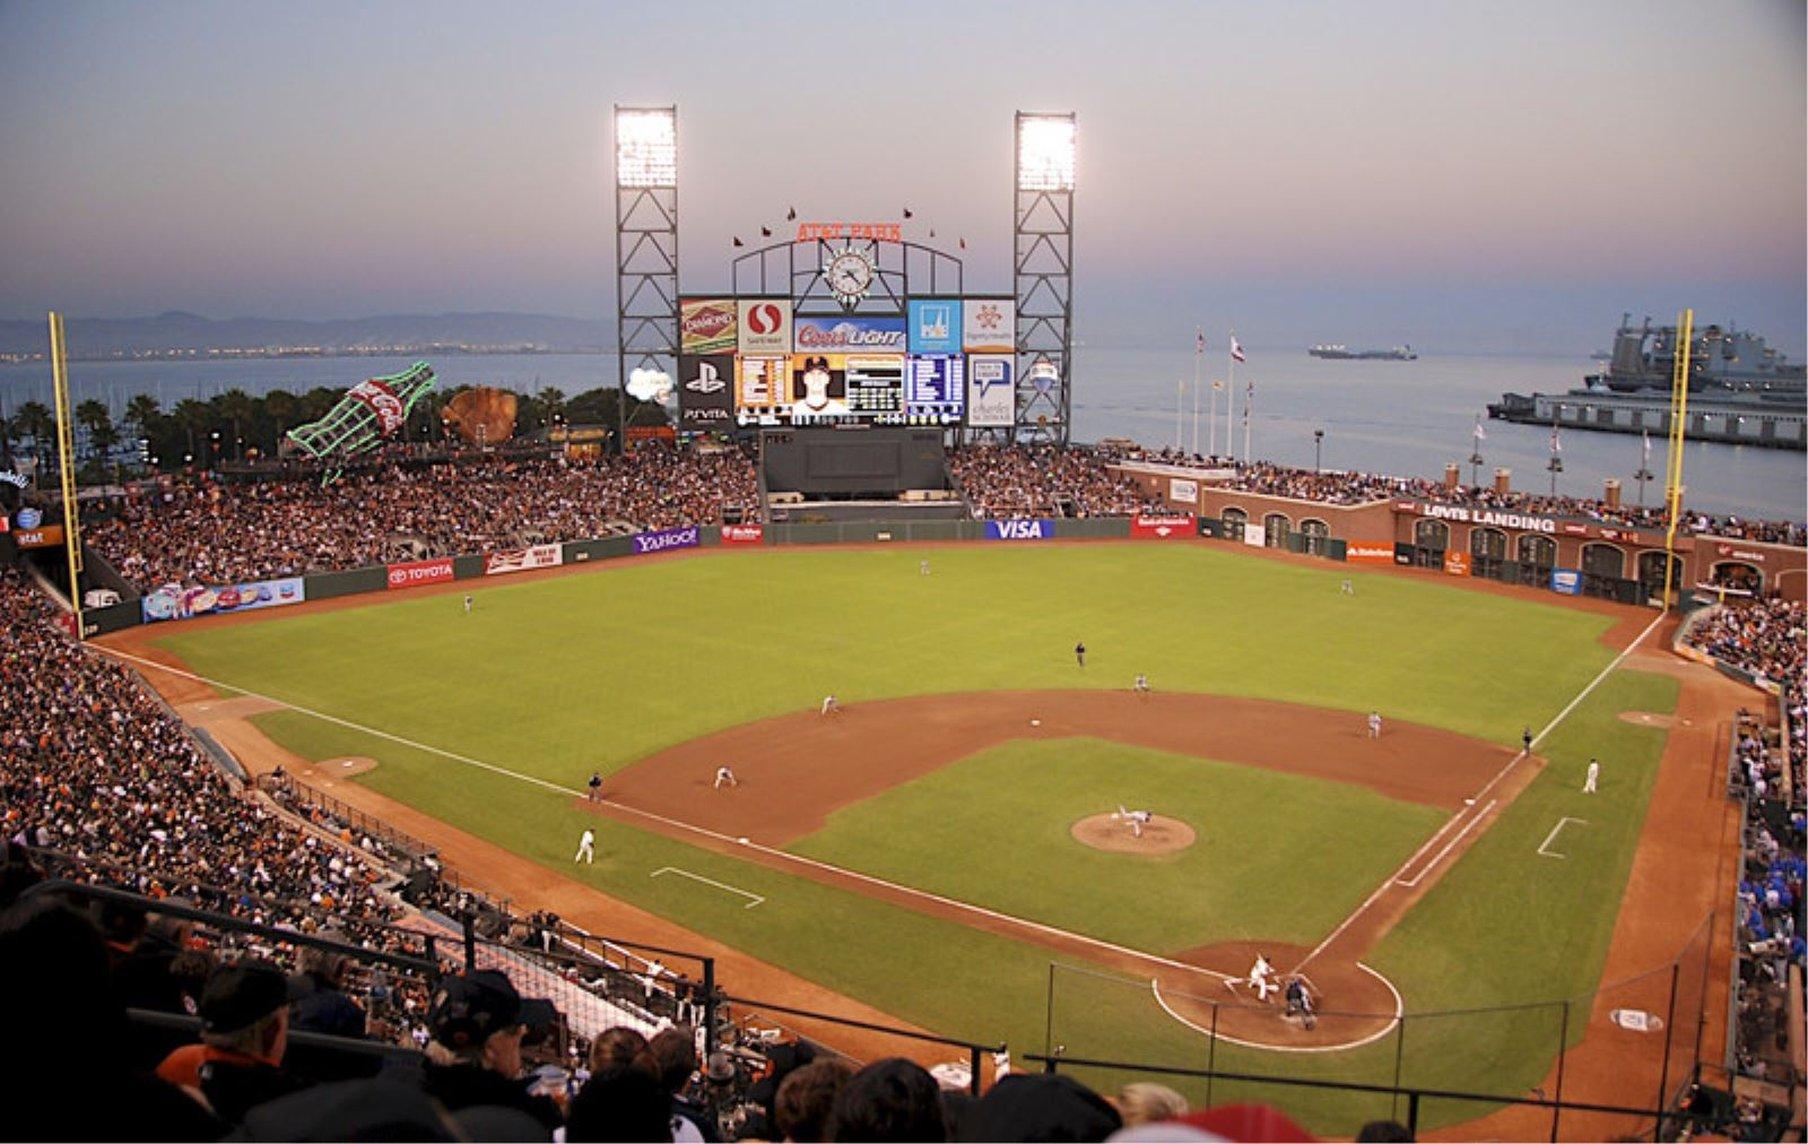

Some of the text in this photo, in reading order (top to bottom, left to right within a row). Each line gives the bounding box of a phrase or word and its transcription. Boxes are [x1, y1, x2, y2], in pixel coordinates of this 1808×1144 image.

[850, 222, 902, 243] PARK
[799, 324, 847, 346] Coors
[848, 330, 903, 345] LIGHT
[995, 521, 1042, 539] VISA
[1472, 509, 1556, 533] LANDING
[637, 528, 697, 552] YAHOO!
[409, 564, 453, 581] TOYOTA
